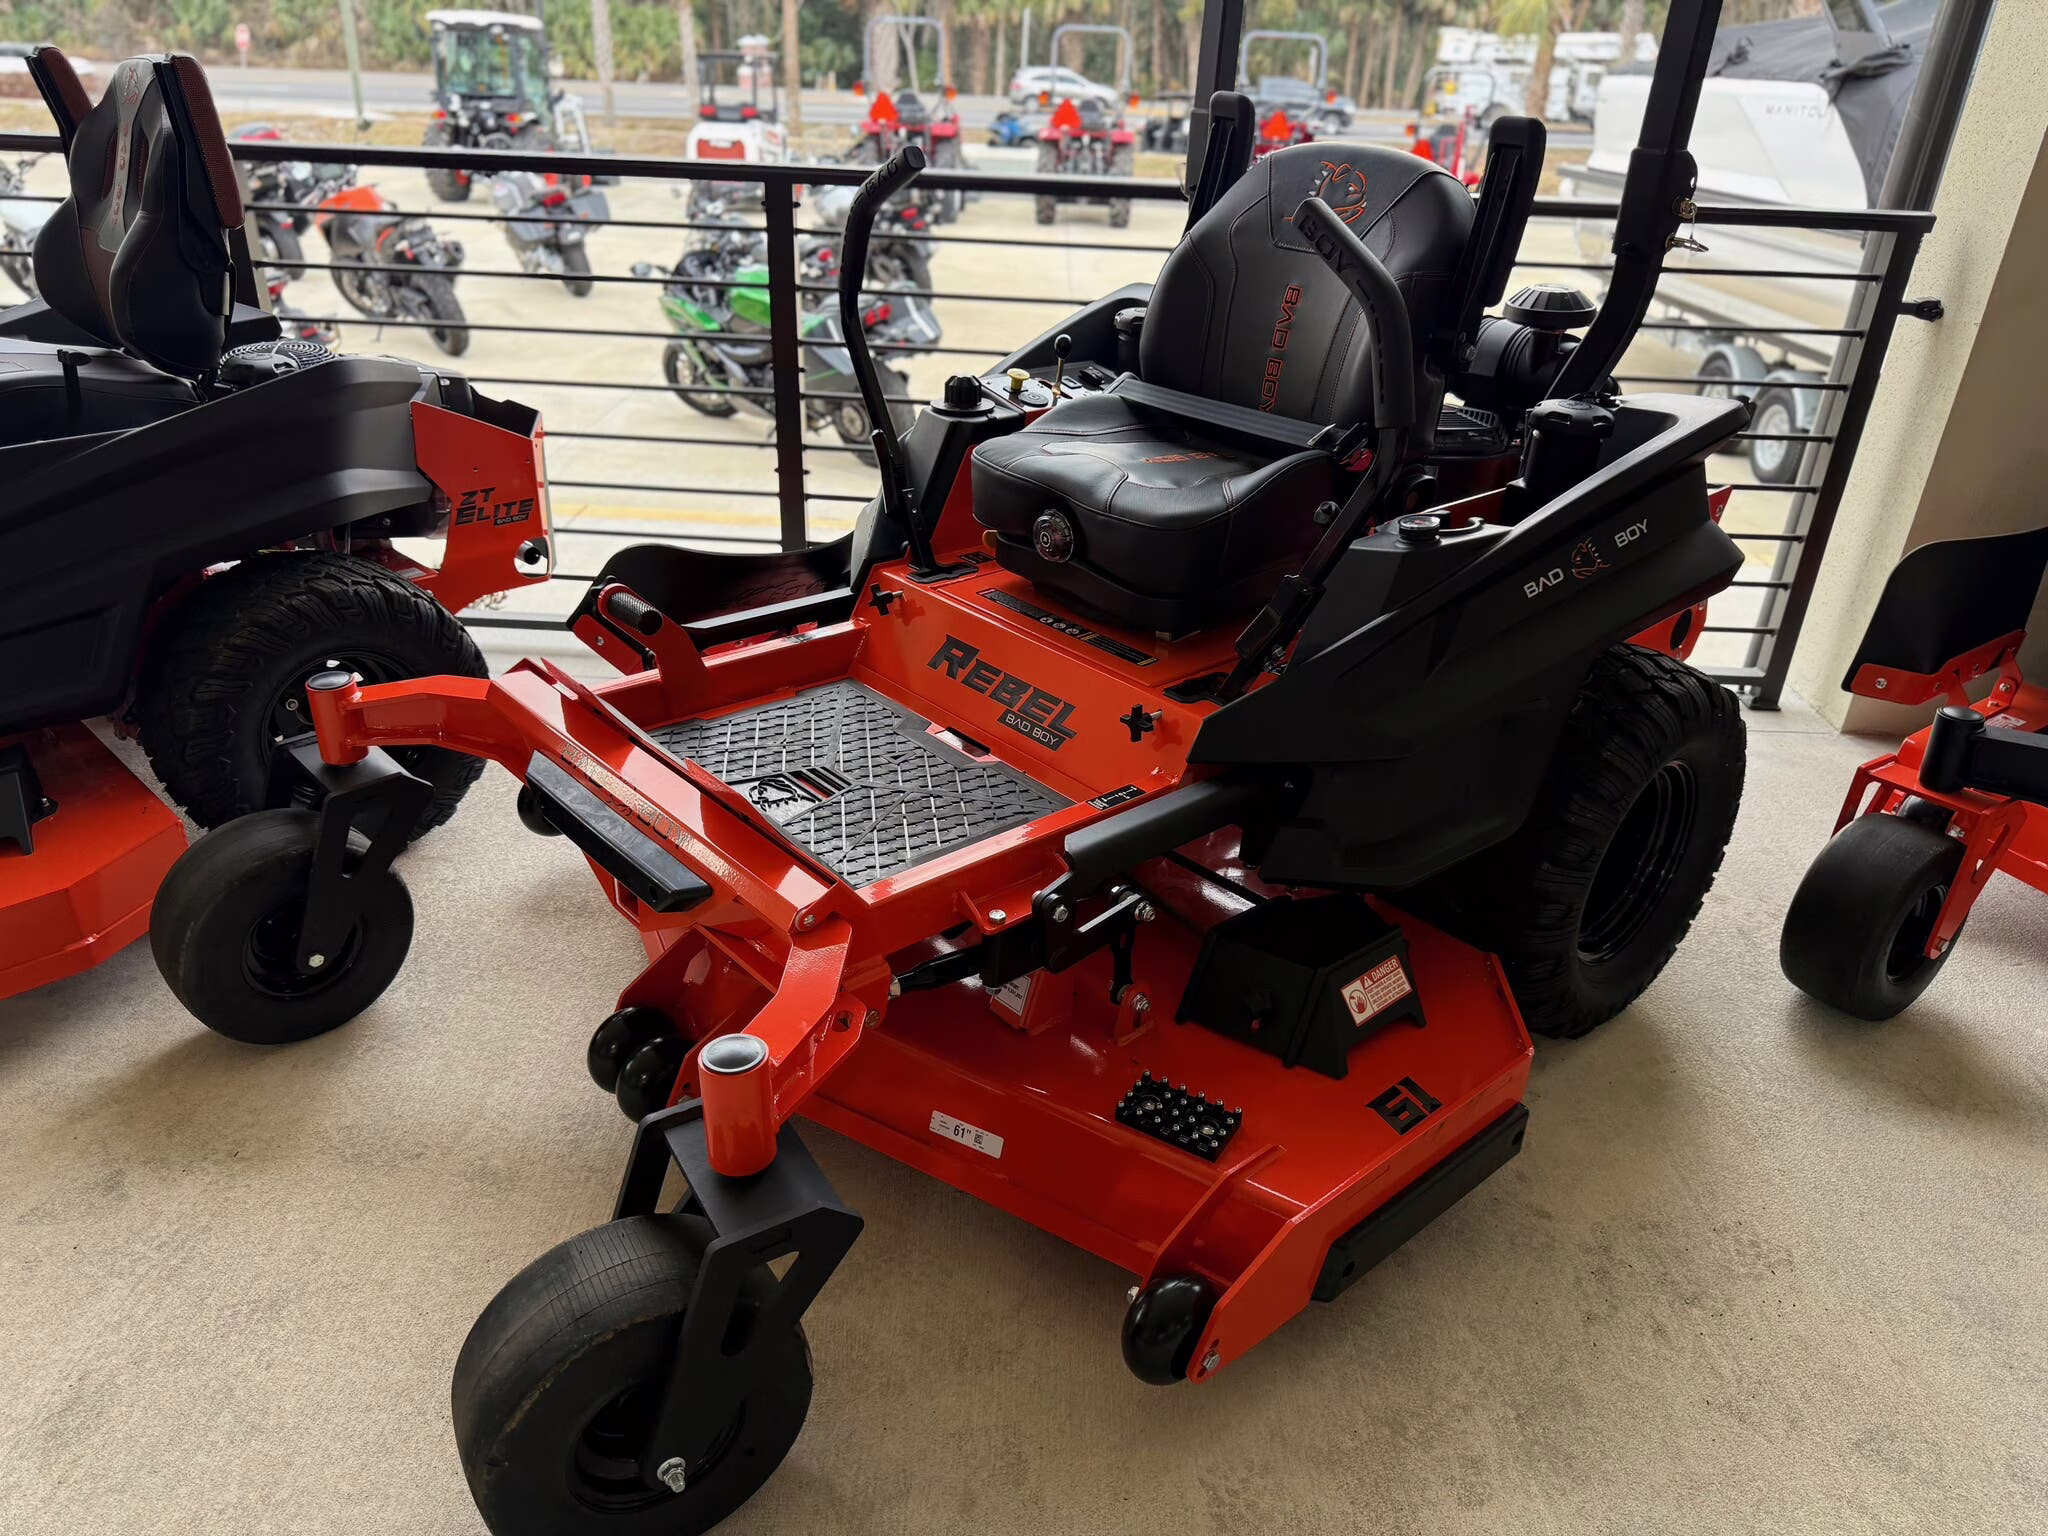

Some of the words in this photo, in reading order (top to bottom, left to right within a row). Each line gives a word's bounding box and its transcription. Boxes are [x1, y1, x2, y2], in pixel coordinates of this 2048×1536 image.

[1275, 284, 1303, 350] BAD
[456, 498, 535, 525] ELITE
[461, 487, 497, 507] ZT
[1523, 568, 1564, 598] BAD
[1614, 519, 1648, 548] BOY
[927, 634, 1078, 740] REBEL
[1005, 713, 1031, 732] BAD
[1032, 727, 1059, 746] BOY
[1371, 959, 1399, 981] DANGER
[1363, 1075, 1444, 1136] 61
[953, 1124, 972, 1139] 61"
